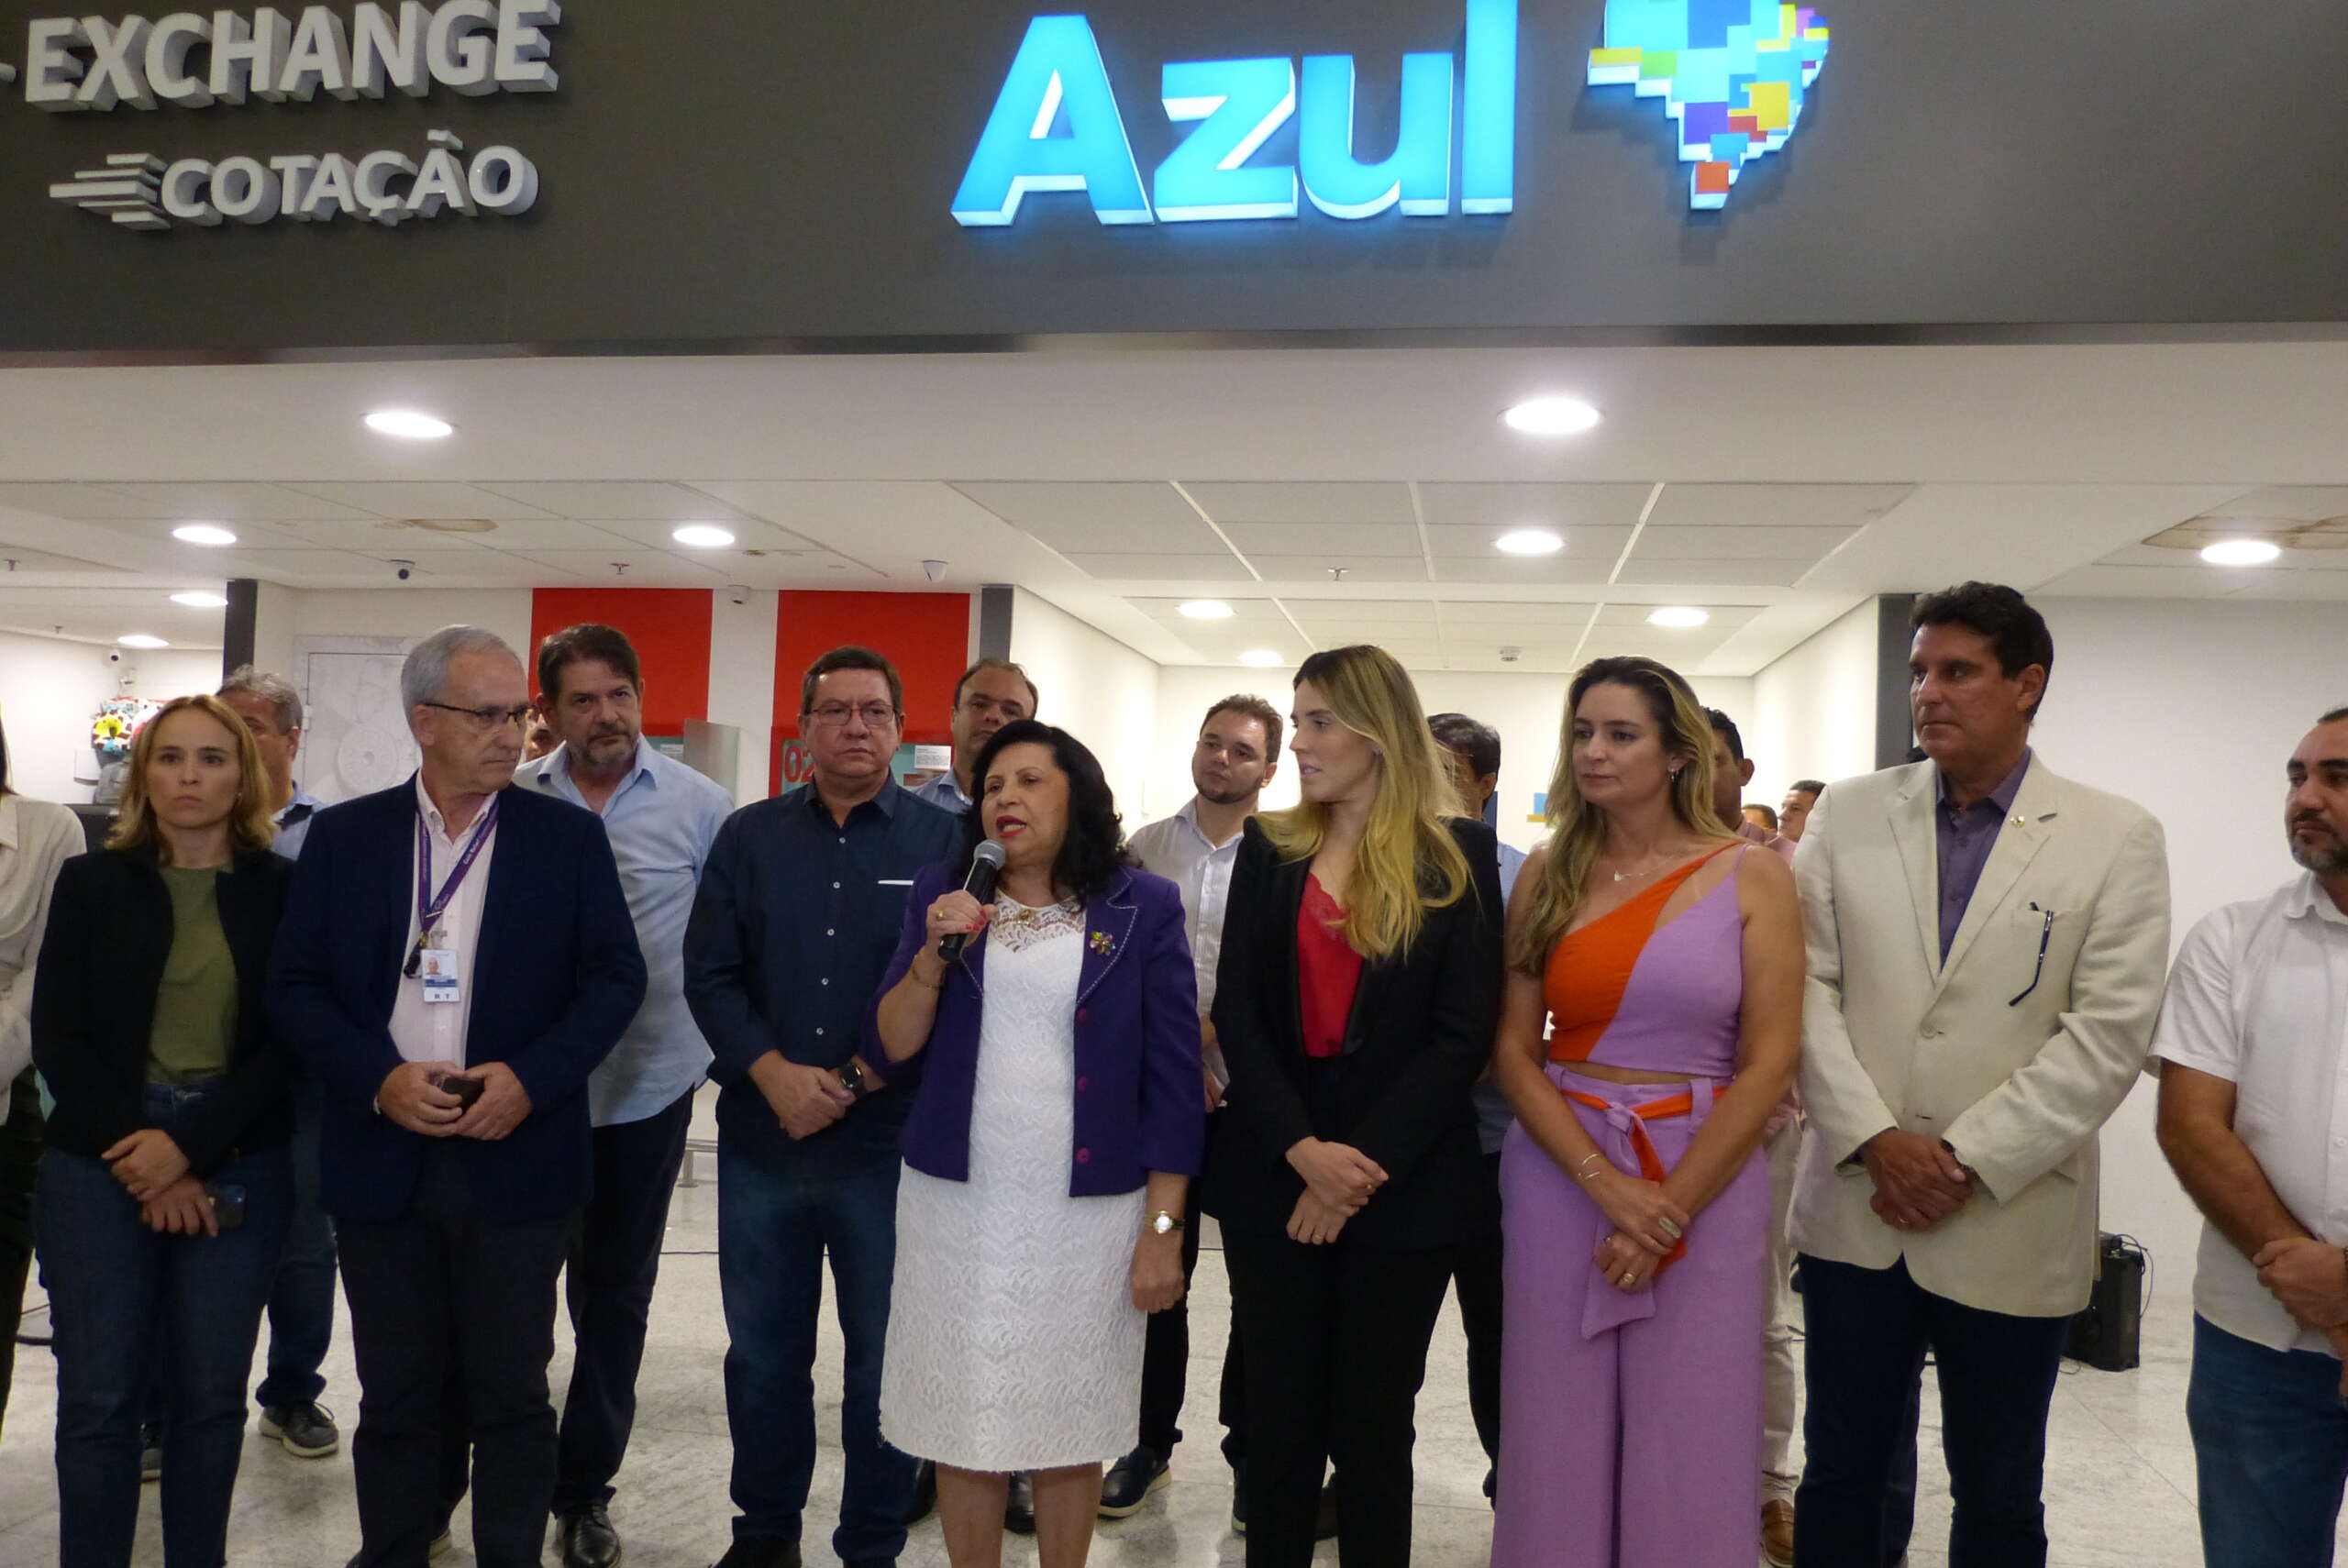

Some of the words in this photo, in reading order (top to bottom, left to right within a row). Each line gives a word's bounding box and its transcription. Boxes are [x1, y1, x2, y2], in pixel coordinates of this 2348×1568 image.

[26, 0, 560, 111] EXCHANGE
[951, 0, 1517, 226] Azul
[161, 129, 539, 226] COTAÇÃO
